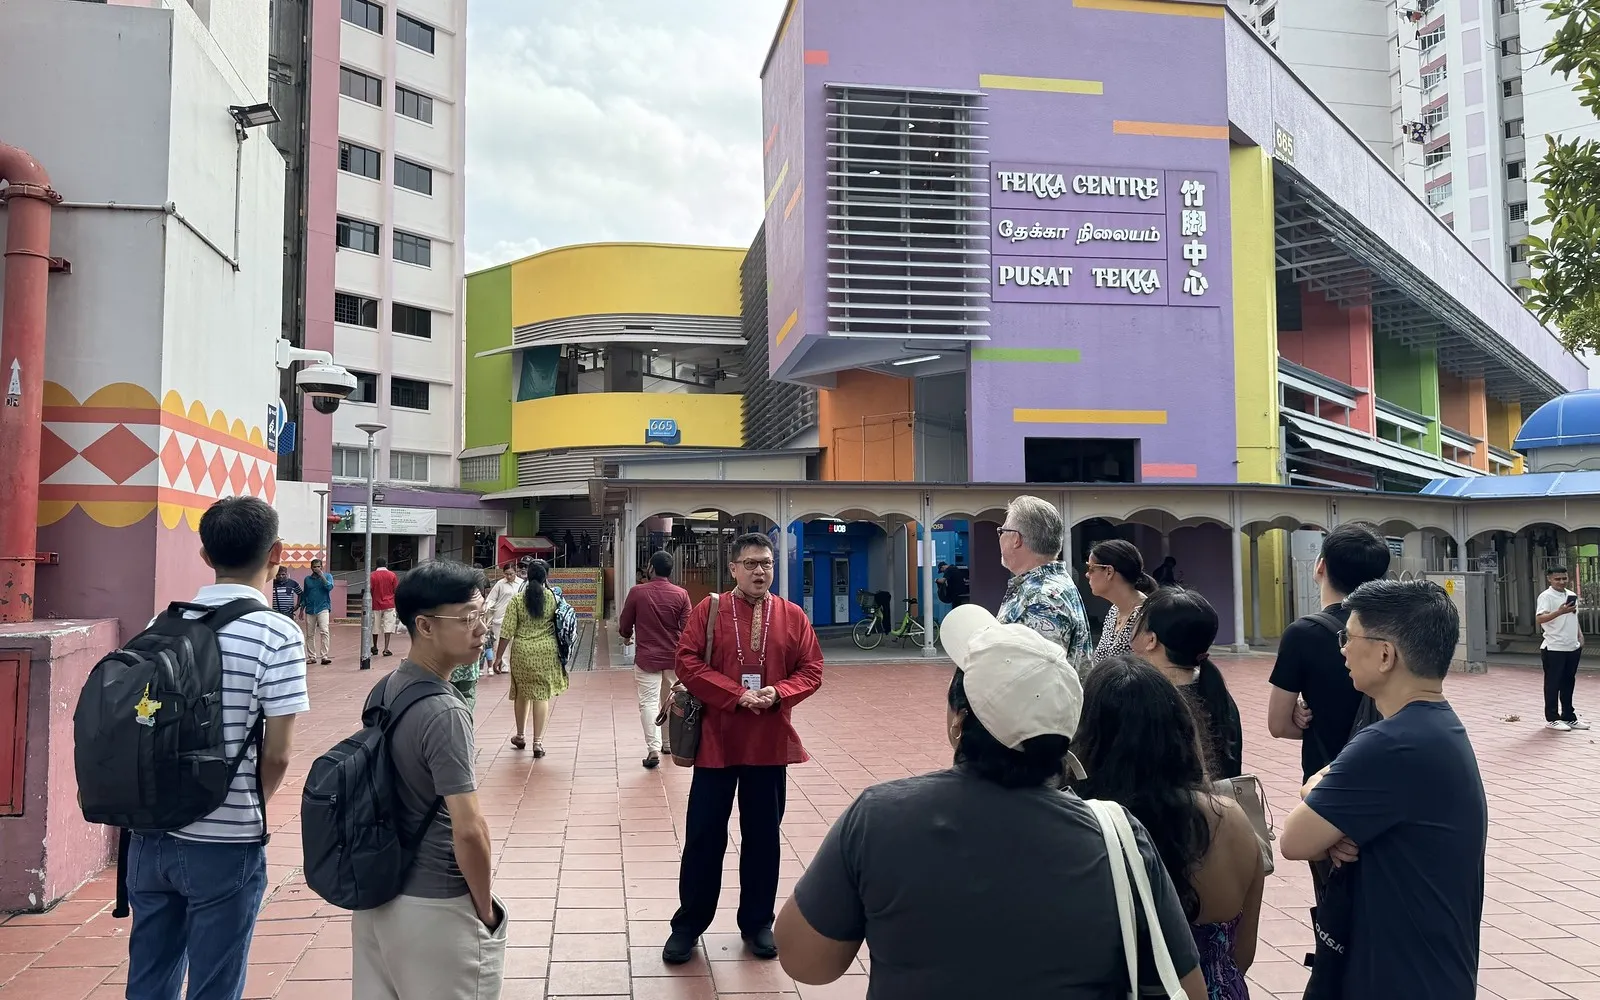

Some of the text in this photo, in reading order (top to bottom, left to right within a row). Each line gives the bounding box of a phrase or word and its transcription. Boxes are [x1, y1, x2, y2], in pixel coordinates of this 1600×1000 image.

[1276, 128, 1293, 156] 665
[997, 171, 1159, 200] TEKKA CENTRE
[998, 219, 1161, 245] தேக்கா நிலையம்
[1181, 179, 1209, 296] 竹脚中心
[999, 265, 1161, 294] PUSAT TEKKA
[651, 420, 672, 431] 665
[834, 524, 846, 533] UOB
